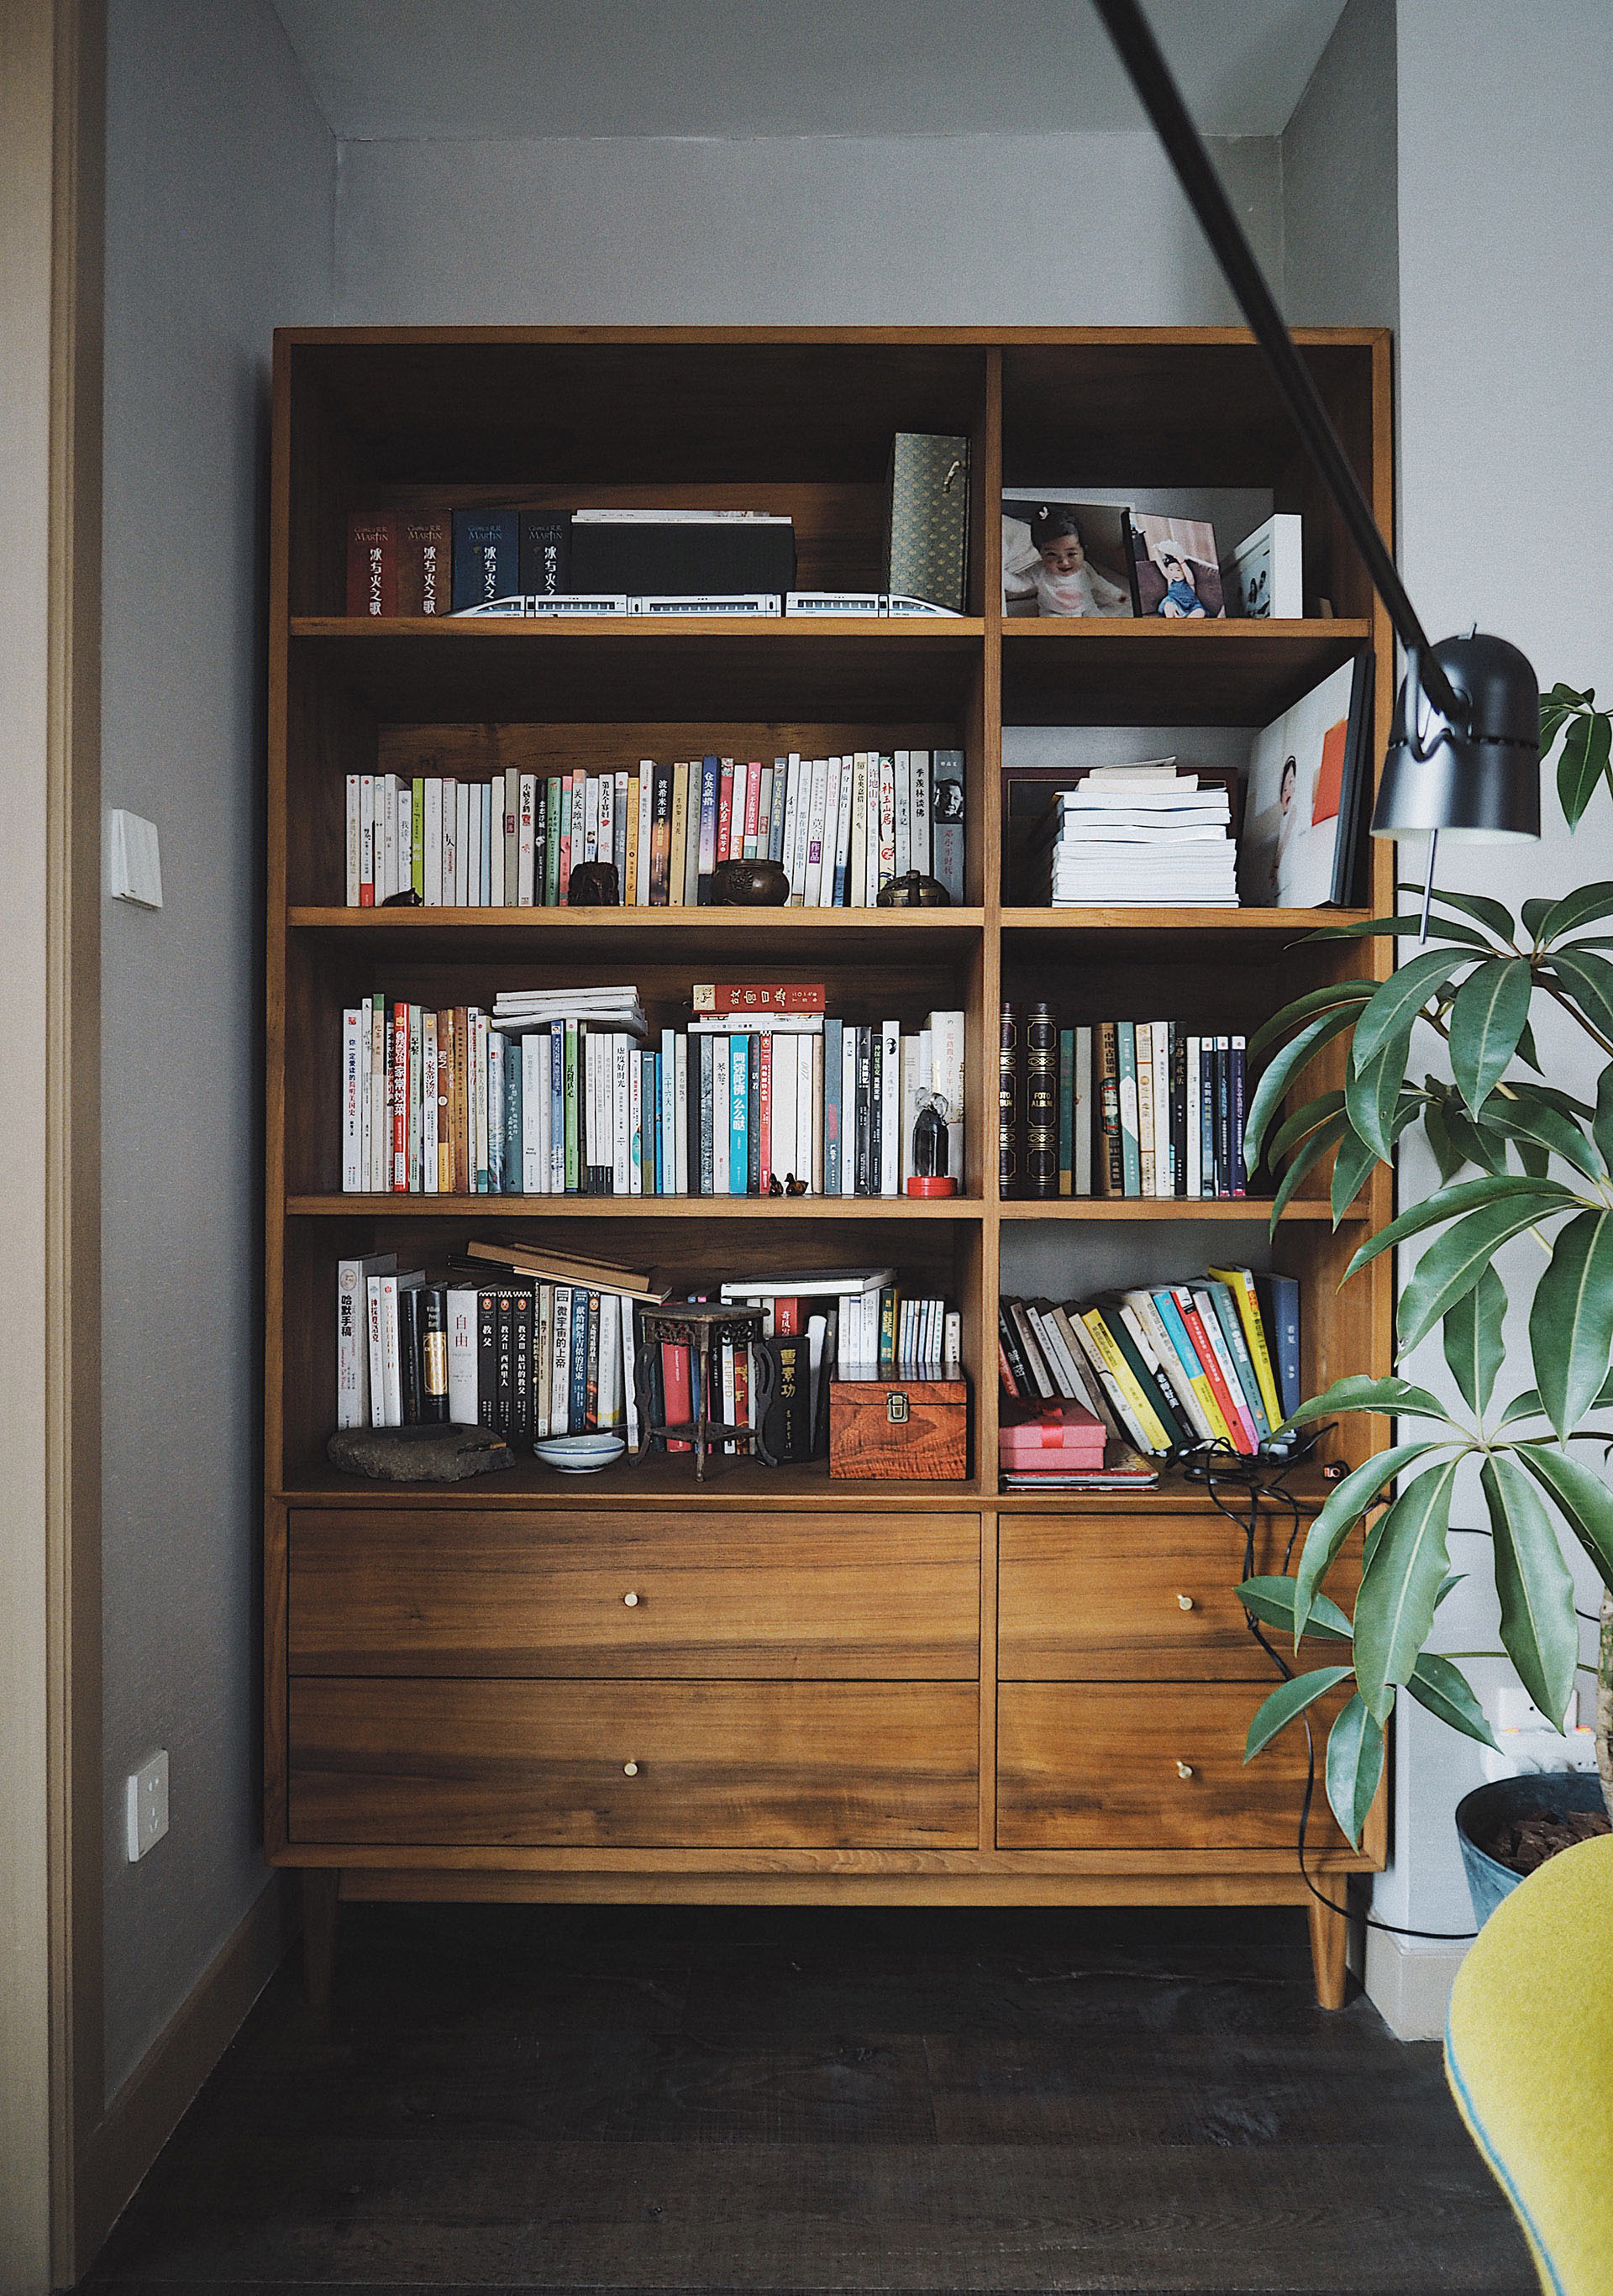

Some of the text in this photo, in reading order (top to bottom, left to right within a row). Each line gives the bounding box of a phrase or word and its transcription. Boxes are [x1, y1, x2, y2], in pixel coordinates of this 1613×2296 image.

[370, 547, 383, 617] 冰与火之歌
[423, 545, 437, 616] 冰与火之歌
[484, 545, 497, 600] 冰与火之
[572, 789, 583, 831] 关关雎鸠
[658, 780, 668, 817] 波希米亚
[880, 782, 894, 826] 补玉山居
[944, 829, 954, 875] 邓小平时代
[617, 1047, 626, 1088] 虚度好时光
[733, 1052, 746, 1131] 阿弥陀佛么么哒
[1031, 1099, 1053, 1107] ALBUM
[1033, 1091, 1051, 1100] FOTO
[341, 1295, 352, 1337] 哈默手稿
[455, 1315, 468, 1348] 自由
[482, 1325, 492, 1347] 教父
[555, 1306, 567, 1369] 微宇宙的上帝
[500, 1354, 509, 1388] 西西里人
[518, 1354, 527, 1395] 最后的教父
[724, 1360, 733, 1399] FLIPPED
[780, 1348, 797, 1399] 曹素功
